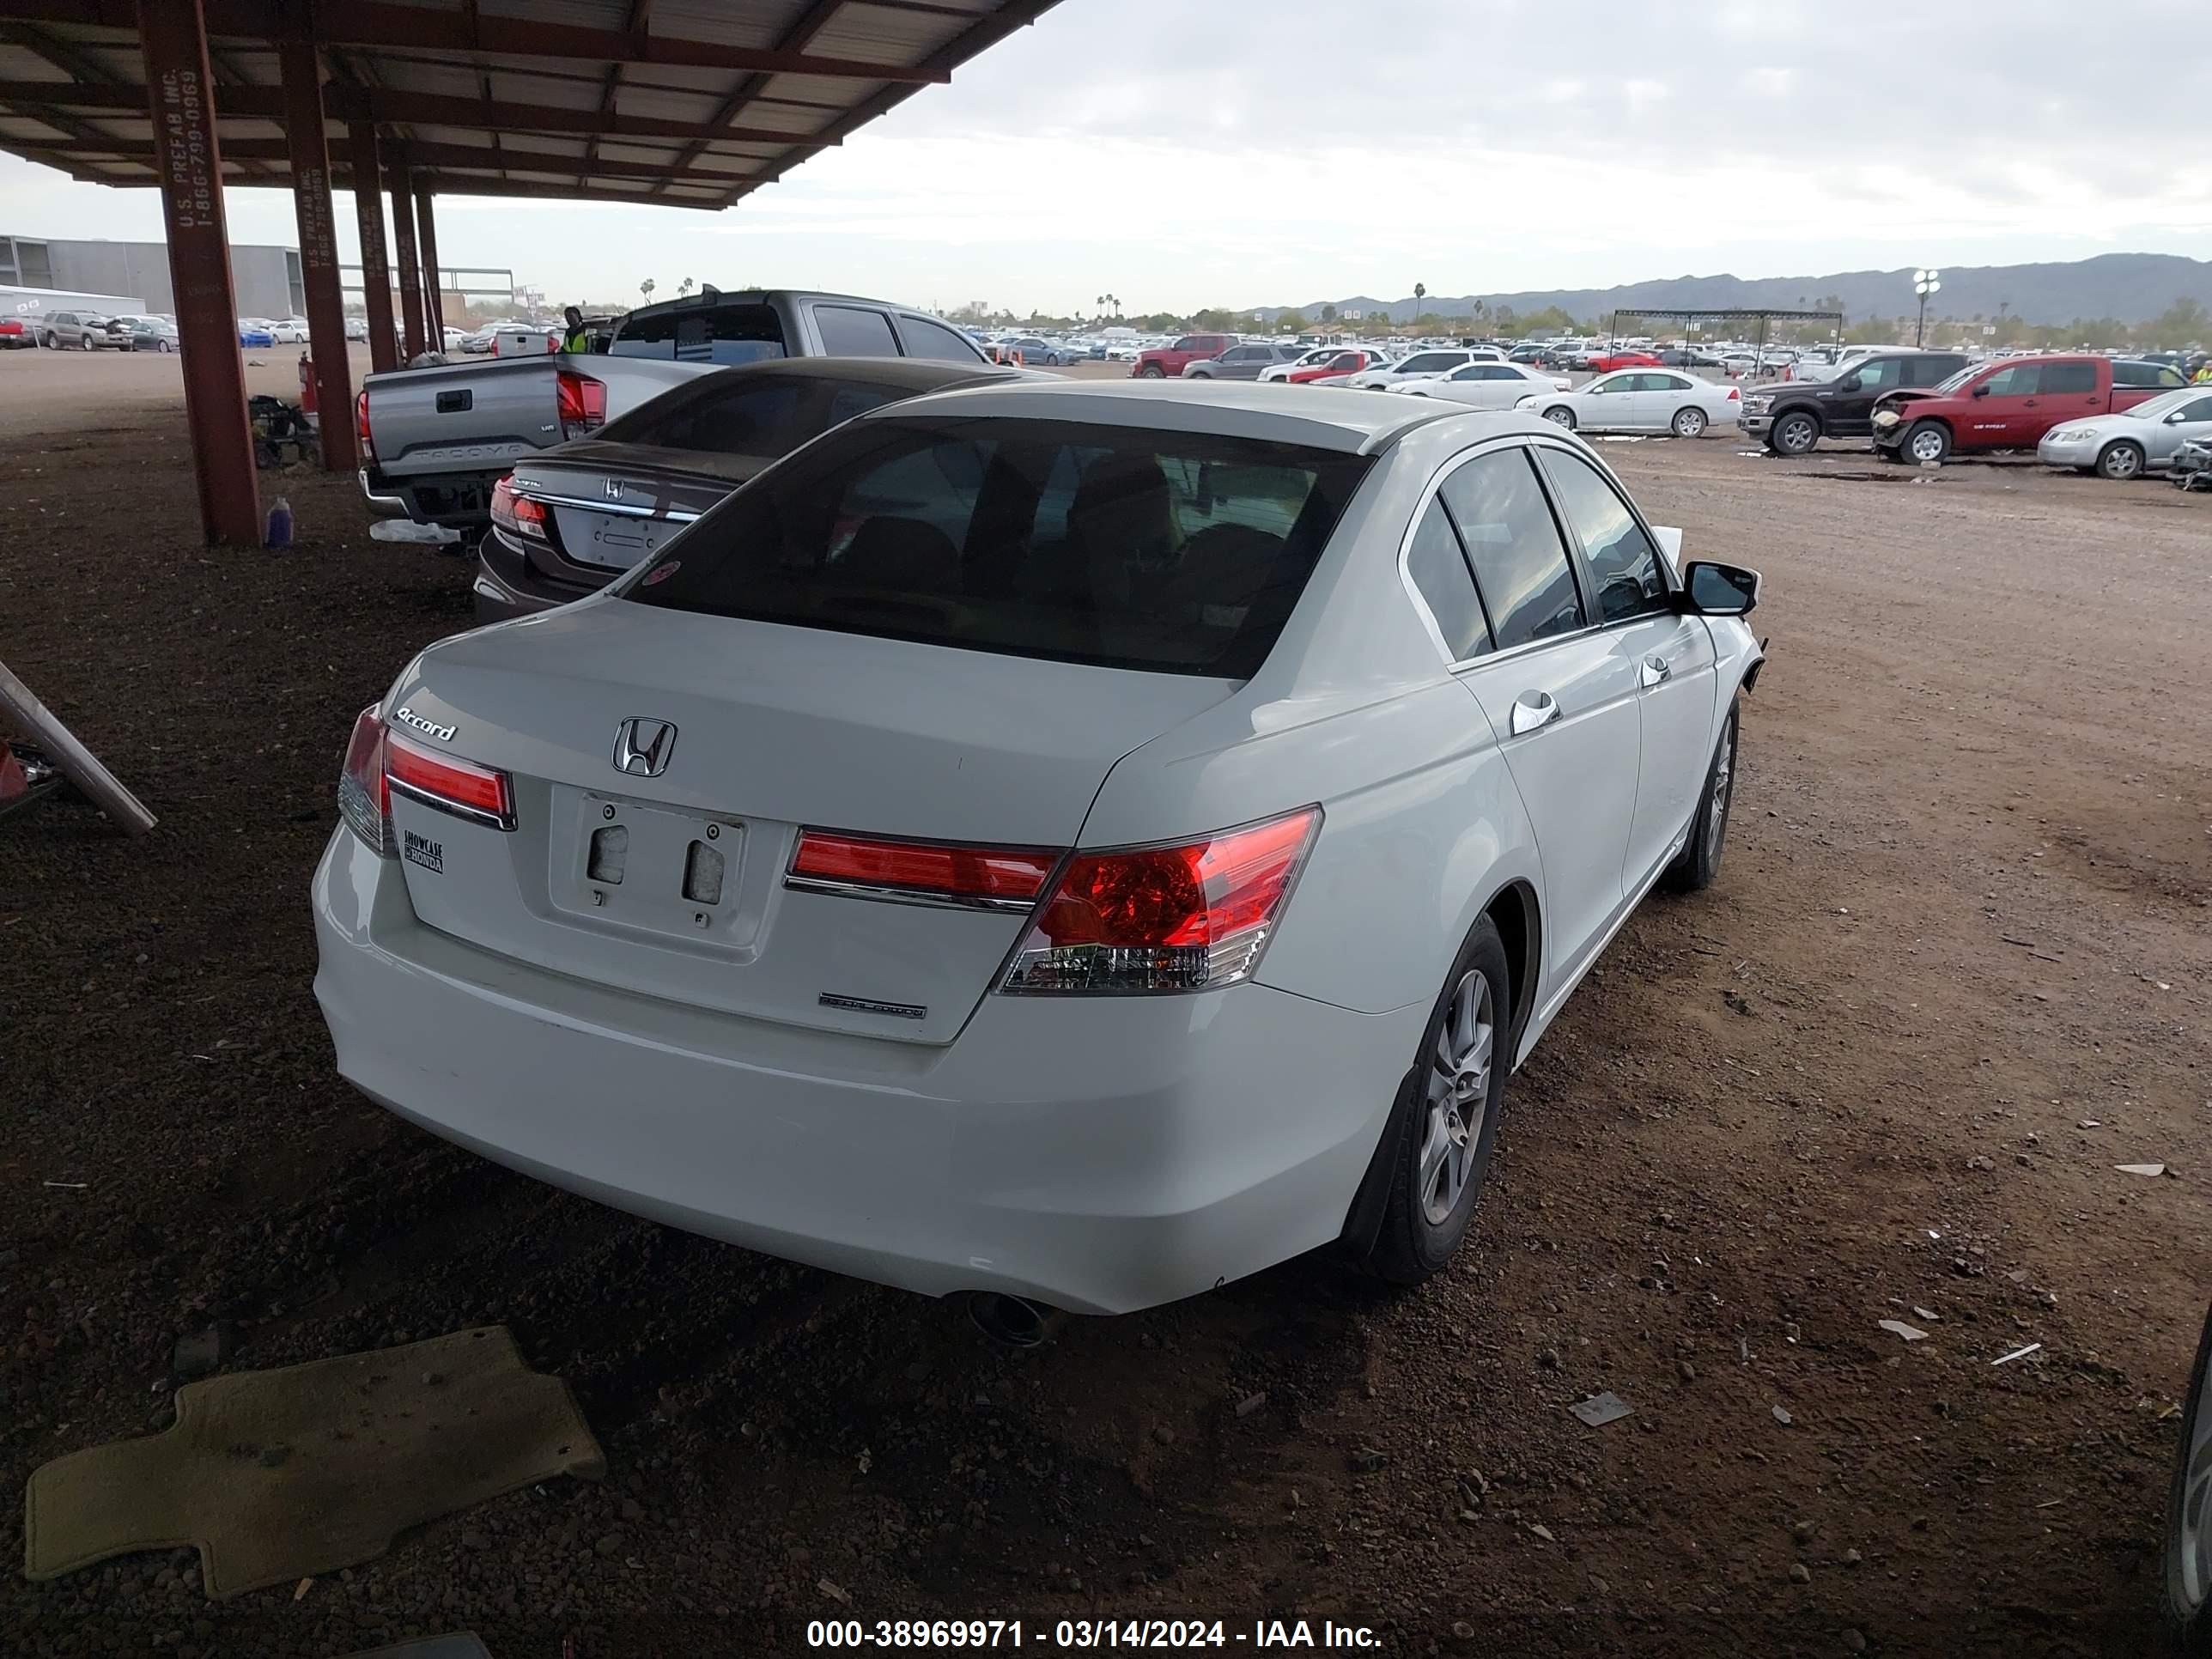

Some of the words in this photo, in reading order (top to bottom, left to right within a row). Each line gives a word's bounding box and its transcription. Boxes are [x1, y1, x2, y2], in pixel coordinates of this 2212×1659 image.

[162, 69, 179, 104] INC.
[166, 112, 188, 183] PREFAB
[180, 70, 213, 226] 1-866-799-0969
[397, 707, 457, 742] Accord
[404, 830, 443, 859] SHOWCASE
[412, 848, 443, 872] HONDA
